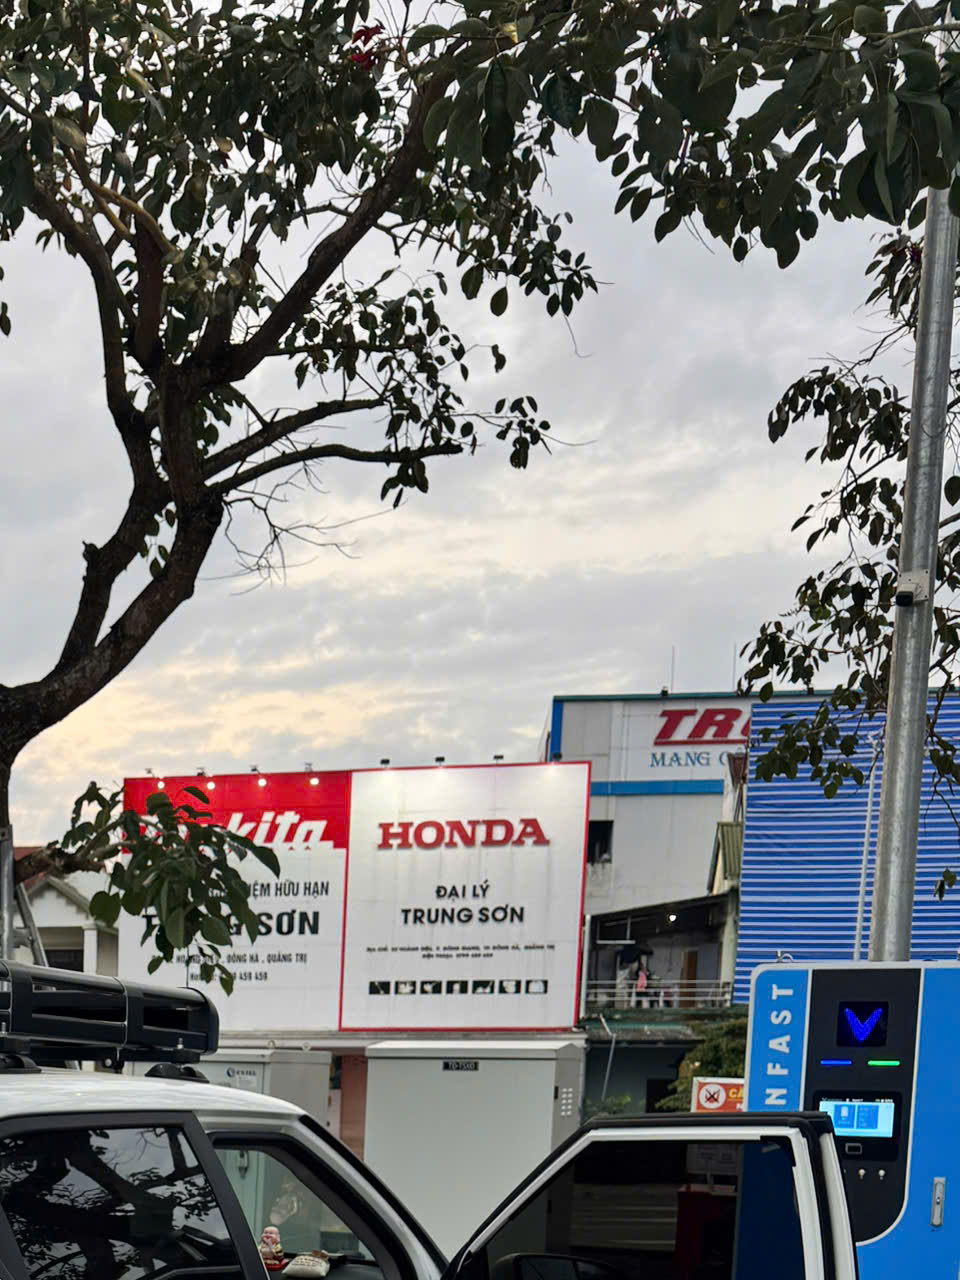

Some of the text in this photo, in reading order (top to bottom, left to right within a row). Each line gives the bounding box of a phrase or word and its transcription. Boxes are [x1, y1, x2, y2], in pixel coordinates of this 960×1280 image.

[655, 708, 751, 740] TR
[377, 818, 551, 850] HONDA
[303, 881, 330, 899] HẠN
[435, 879, 490, 902] ĐẠI LÝ
[257, 909, 320, 936] SƠN
[401, 904, 525, 925] TRUNG SƠN
[764, 984, 794, 1105] NFAST
